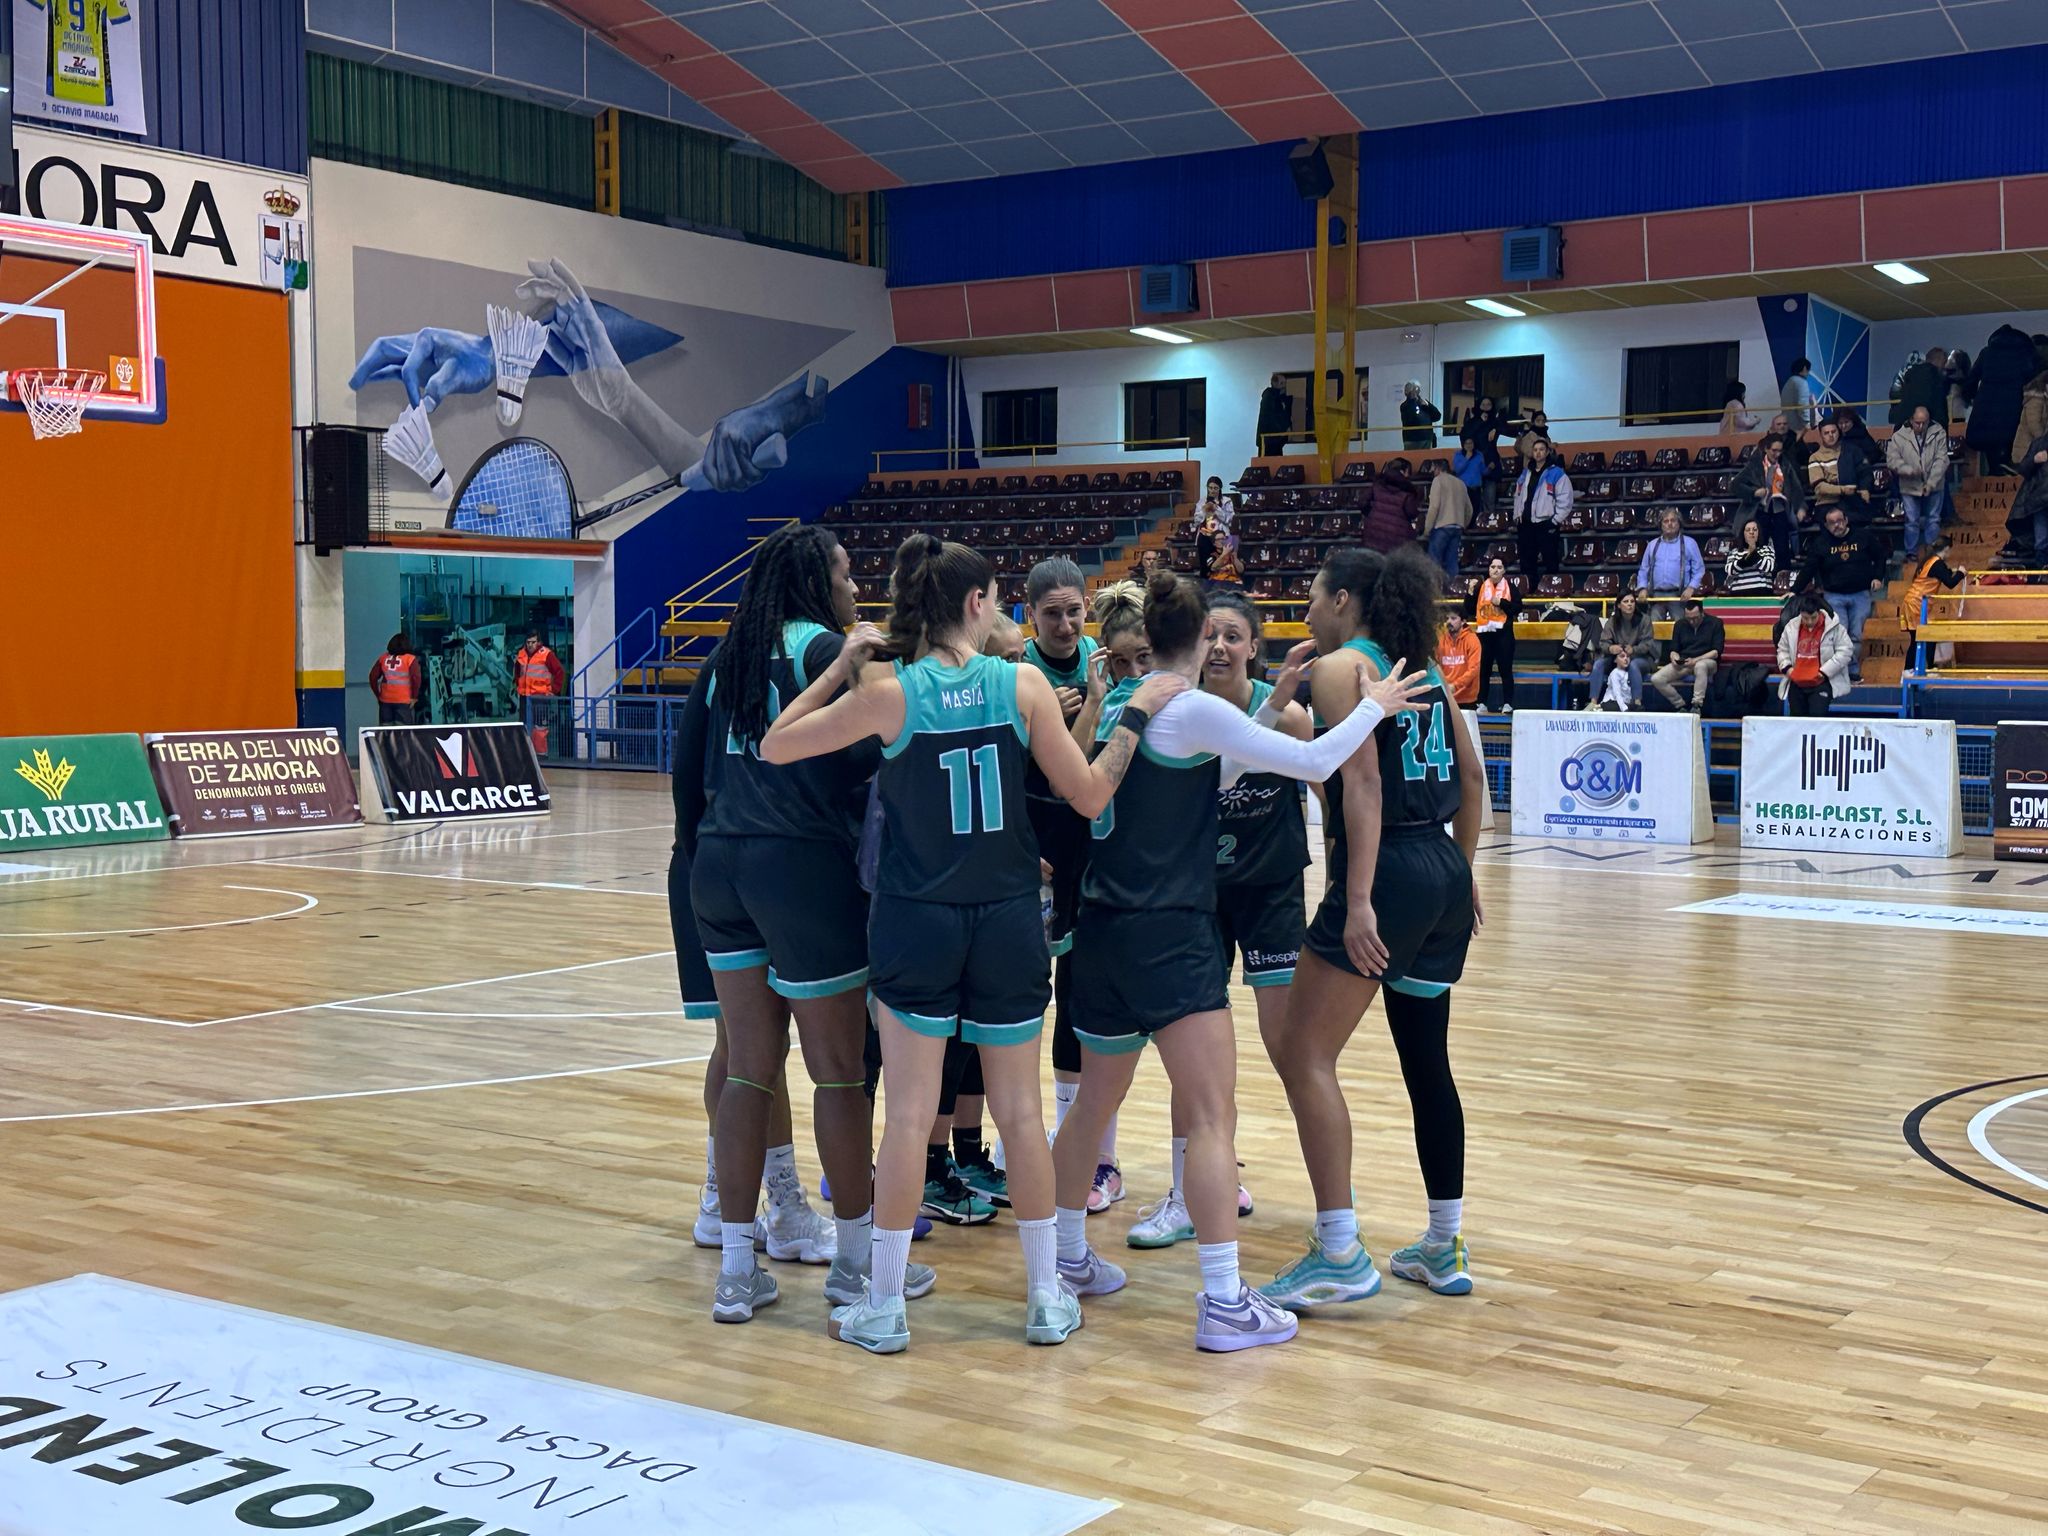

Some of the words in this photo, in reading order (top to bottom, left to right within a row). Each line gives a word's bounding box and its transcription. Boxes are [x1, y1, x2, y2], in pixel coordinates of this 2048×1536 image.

[68, 0, 85, 32] 9
[51, 104, 82, 116] OCTAVIO
[13, 149, 238, 266] ORA
[152, 741, 239, 762] TIERRA
[241, 740, 285, 759] DEL
[286, 737, 340, 757] VINO
[1395, 701, 1454, 782] 24
[188, 765, 221, 784] DE
[224, 760, 322, 783] ZAMORA
[1559, 757, 1642, 794] C&M
[194, 783, 272, 800] DENOMINACIÓN
[274, 785, 288, 796] DE
[291, 782, 327, 794] ORIGEN
[397, 784, 538, 814] VALCARCE
[938, 743, 1004, 835] 11
[0, 808, 47, 840] JA
[1755, 802, 1887, 827] HERBI-PLAST,
[1896, 808, 1932, 826] S.L.
[1756, 823, 1932, 843] SEÑALIZACIONES
[299, 1382, 489, 1431] GROUP
[35, 1359, 629, 1519] INGREDIENTS
[497, 1424, 698, 1482] DACSA
